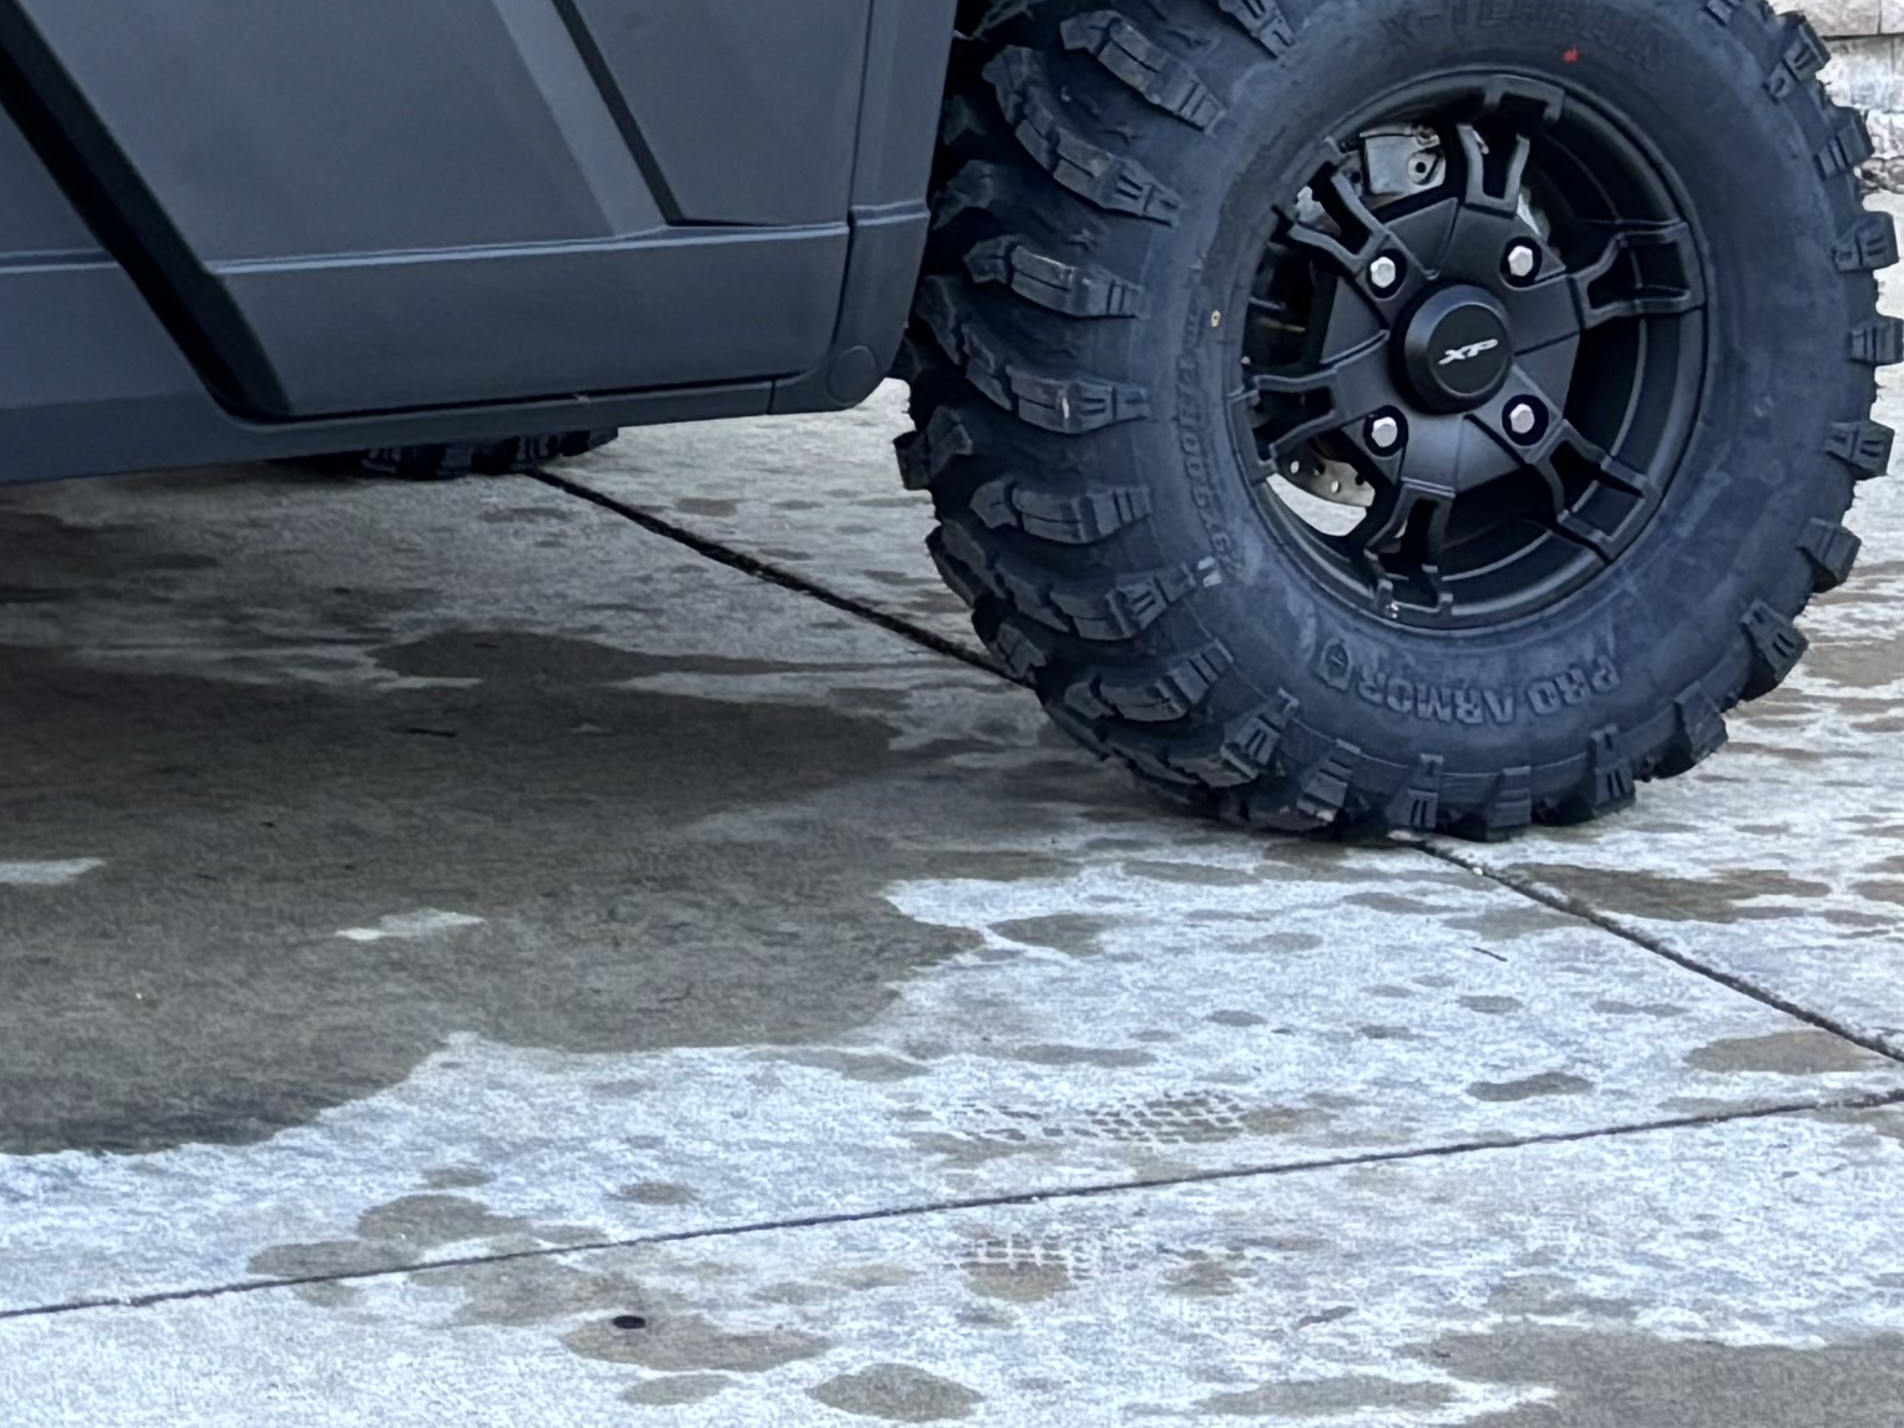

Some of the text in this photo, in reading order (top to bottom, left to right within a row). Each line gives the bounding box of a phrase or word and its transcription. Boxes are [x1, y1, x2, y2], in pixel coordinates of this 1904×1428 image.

[1438, 338, 1498, 365] XP
[1356, 653, 1622, 725] PRO ARMOR
